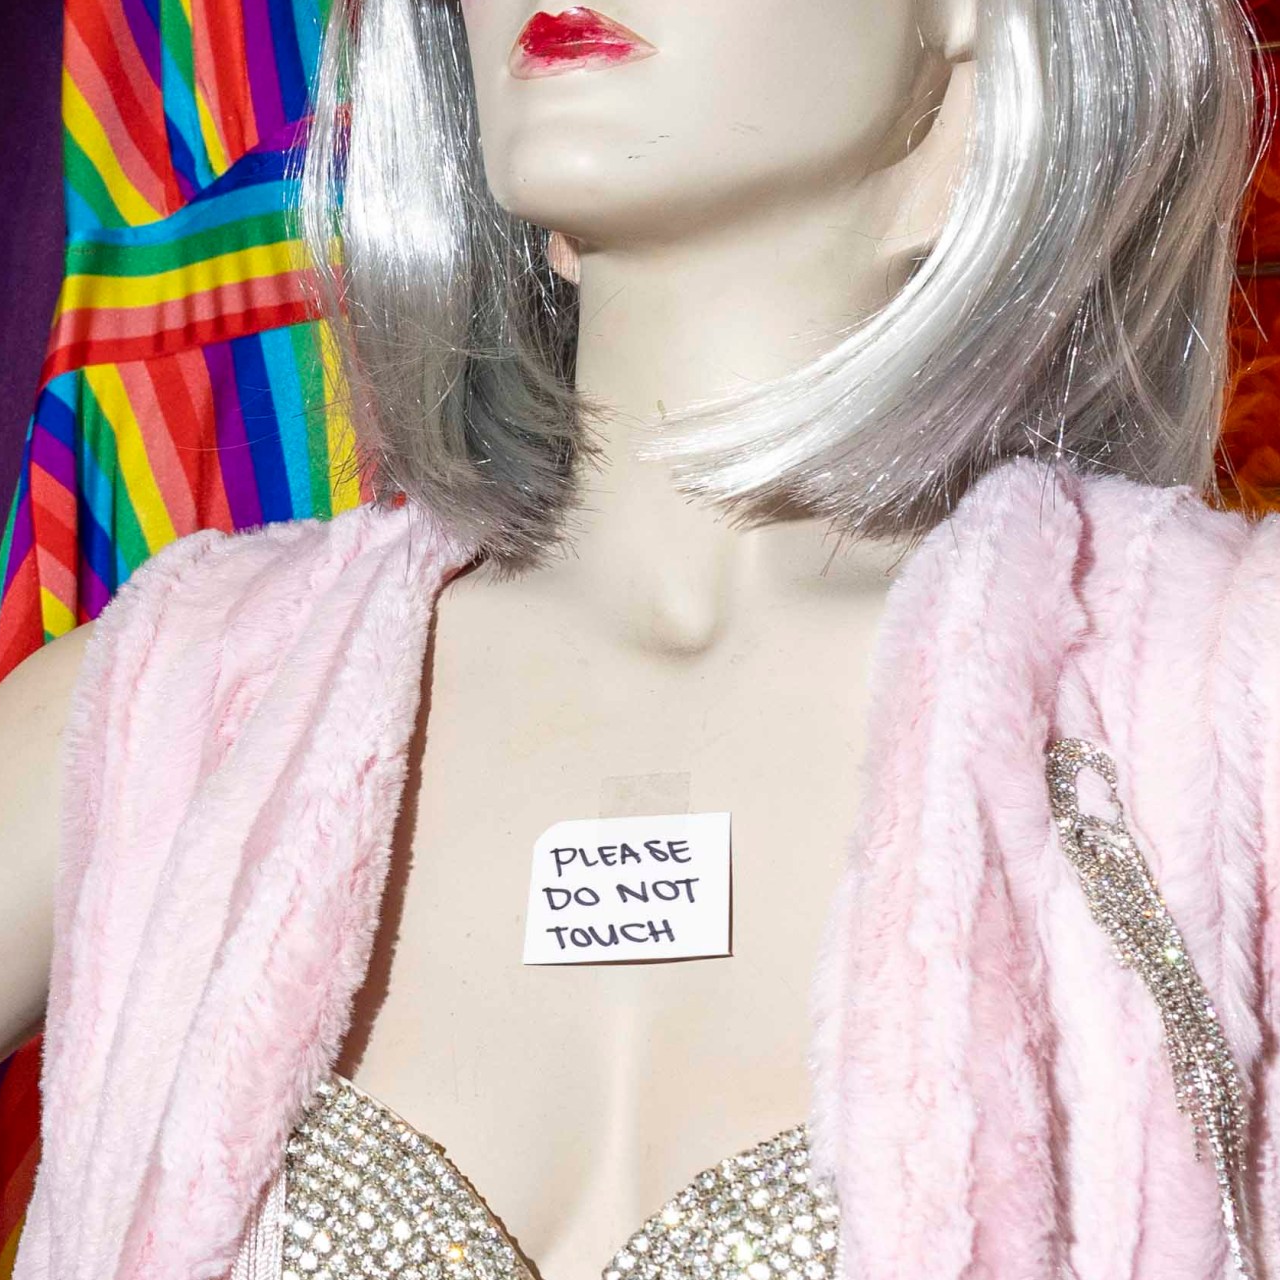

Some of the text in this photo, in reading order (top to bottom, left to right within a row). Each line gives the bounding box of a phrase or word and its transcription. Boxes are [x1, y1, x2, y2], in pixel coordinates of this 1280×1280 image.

[549, 840, 692, 878] PLEASE
[542, 878, 700, 911] DO NOT
[546, 919, 676, 951] TOUCH
